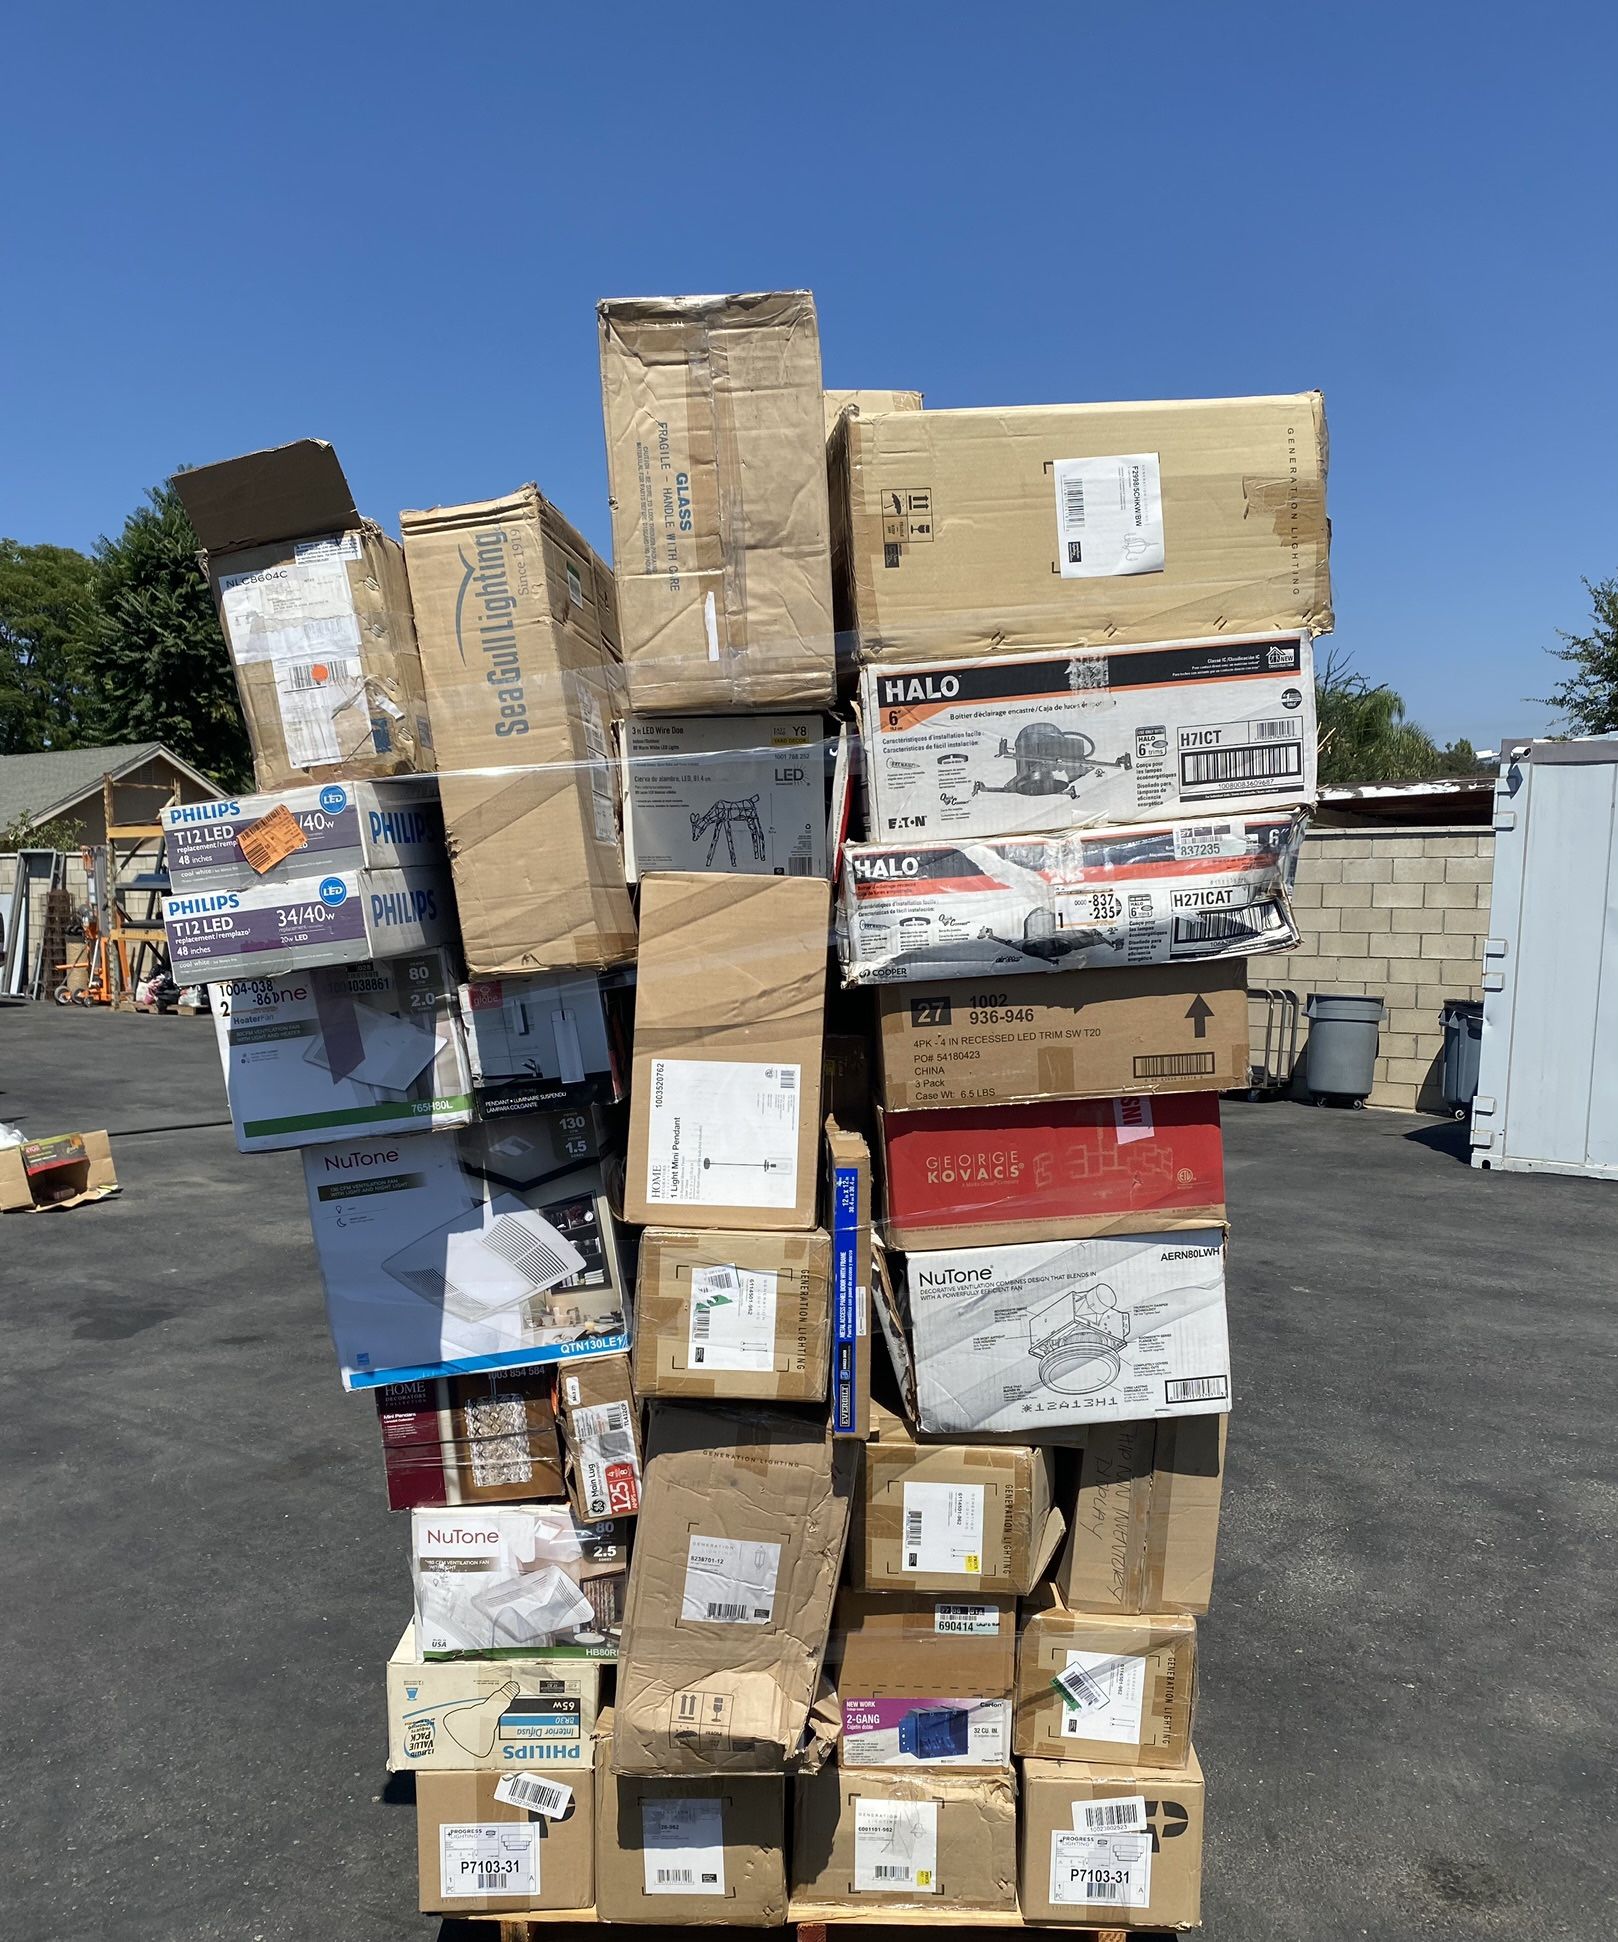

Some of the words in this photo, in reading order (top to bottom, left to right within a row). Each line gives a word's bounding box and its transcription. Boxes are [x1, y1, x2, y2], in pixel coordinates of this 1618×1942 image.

[658, 422, 671, 470] FRAGILE
[1287, 427, 1298, 520] GENERATION
[663, 487, 675, 528] HANDLE
[676, 472, 692, 532] GLASS
[510, 529, 525, 559] 1919
[666, 533, 678, 563] WITH
[1291, 527, 1300, 596] LIGHTING
[226, 570, 288, 588] NLC8604C
[518, 562, 530, 596] Since
[885, 675, 960, 703] HALO
[1054, 703, 1063, 711] de
[642, 727, 655, 735] LED
[656, 726, 671, 735] Wire
[793, 726, 807, 736] Y8
[1180, 730, 1222, 746] H7ICT
[774, 768, 804, 782] LED
[324, 792, 344, 804] LED
[170, 801, 241, 824] PHILIPS
[299, 813, 334, 831] /40w
[368, 810, 436, 844] PHILIPS
[174, 828, 204, 846] T12
[205, 825, 235, 842] LED
[176, 839, 238, 853] replacement/remp
[1180, 842, 1220, 856] 837235
[178, 854, 191, 865] 48
[191, 854, 213, 864] inches
[854, 857, 919, 878] HALO
[181, 870, 194, 878] cool
[194, 868, 212, 876] white
[323, 884, 344, 897] LED
[168, 894, 240, 916] PHILIPS
[1088, 893, 1114, 908] -837
[276, 904, 335, 927] 34/40w
[370, 890, 437, 928] PHILIPS
[1089, 905, 1115, 920] -235
[173, 920, 203, 938] T12
[204, 916, 234, 934] LED
[1058, 912, 1064, 928] 1
[294, 933, 308, 942] LED
[177, 946, 189, 956] 48
[189, 945, 211, 955] inches
[179, 961, 193, 969] cool
[193, 959, 211, 968] white
[409, 967, 429, 980] 80
[872, 968, 907, 977] COOPER
[220, 980, 274, 997] 1004-038
[411, 992, 436, 1008] 2.0
[474, 994, 499, 1007] globe
[969, 993, 1008, 1009] 1002
[220, 1002, 231, 1017] 2
[917, 1001, 946, 1025] 27
[969, 1008, 1035, 1026] 936-946
[913, 1039, 932, 1049] 4PK
[940, 1037, 947, 1046] 4
[948, 1036, 959, 1046] IN
[961, 1033, 1016, 1046] RECESSED
[1017, 1031, 1037, 1043] LED
[1038, 1029, 1064, 1041] TRIM
[1065, 1029, 1083, 1039] SW
[1084, 1027, 1102, 1038] T20
[914, 1053, 935, 1064] PO#
[936, 1050, 981, 1062] 54180423
[915, 1066, 945, 1076] CHINA
[655, 1063, 665, 1109] 1003520762
[915, 1078, 921, 1088] 3
[922, 1077, 945, 1088] Pack
[915, 1090, 938, 1100] Case
[960, 1088, 975, 1099] 6.5
[976, 1087, 996, 1098] LBS
[411, 1100, 454, 1117] 765H80L
[485, 1098, 510, 1107] PENDANT
[559, 1116, 586, 1131] 130
[672, 1116, 681, 1151] Pendant
[565, 1140, 587, 1154] 1.5
[324, 1151, 399, 1172] NuTone
[671, 1152, 679, 1170] Mini
[926, 1150, 1019, 1171] GEORGE
[651, 1164, 662, 1199] HOME
[670, 1171, 680, 1192] Light
[927, 1166, 1020, 1184] KOVACS
[1160, 1247, 1221, 1262] AERN80LWH
[919, 1267, 993, 1286] NuTone
[920, 1286, 957, 1295] DECORATIVE
[957, 1282, 996, 1291] VENTILATION
[996, 1279, 1028, 1288] COMBINES
[1027, 1276, 1051, 1285] DESIGN
[1050, 1274, 1066, 1282] THAT
[1066, 1272, 1088, 1280] BLENDS
[840, 1279, 848, 1291] DOOR
[798, 1268, 810, 1324] GENERATION
[840, 1291, 848, 1306] PANEL
[941, 1289, 980, 1299] POWERFULLY
[839, 1324, 847, 1338] METAL
[797, 1327, 808, 1370] LIGHTING
[510, 1368, 527, 1378] 854
[528, 1366, 545, 1376] 584
[385, 1382, 426, 1396] HOME
[385, 1393, 427, 1401] DECORATORS
[841, 1384, 850, 1425] EVERBILT
[702, 1450, 757, 1463] GENERATION
[759, 1459, 800, 1468] LIGHTING
[587, 1463, 597, 1479] Lug
[589, 1479, 600, 1498] Main
[609, 1480, 632, 1512] 125
[1003, 1484, 1014, 1533] GENERATION
[595, 1522, 615, 1534] 80
[427, 1528, 500, 1545] NuTone
[593, 1545, 617, 1558] 2.5
[1002, 1537, 1012, 1575] LIGHTING
[938, 1620, 974, 1632] 690414
[1164, 1657, 1176, 1705] GENERATION
[552, 1701, 576, 1711] 65w
[846, 1713, 880, 1725] 2-GANG
[1162, 1708, 1174, 1744] LIGHTING
[410, 1731, 431, 1742] PACK
[516, 1727, 542, 1738] Difusa
[543, 1727, 574, 1737] Interior
[409, 1739, 434, 1751] VALUE
[503, 1745, 580, 1760] PHILIPS
[460, 1860, 520, 1875] P7103-31
[1070, 1868, 1131, 1885] P7103-31
